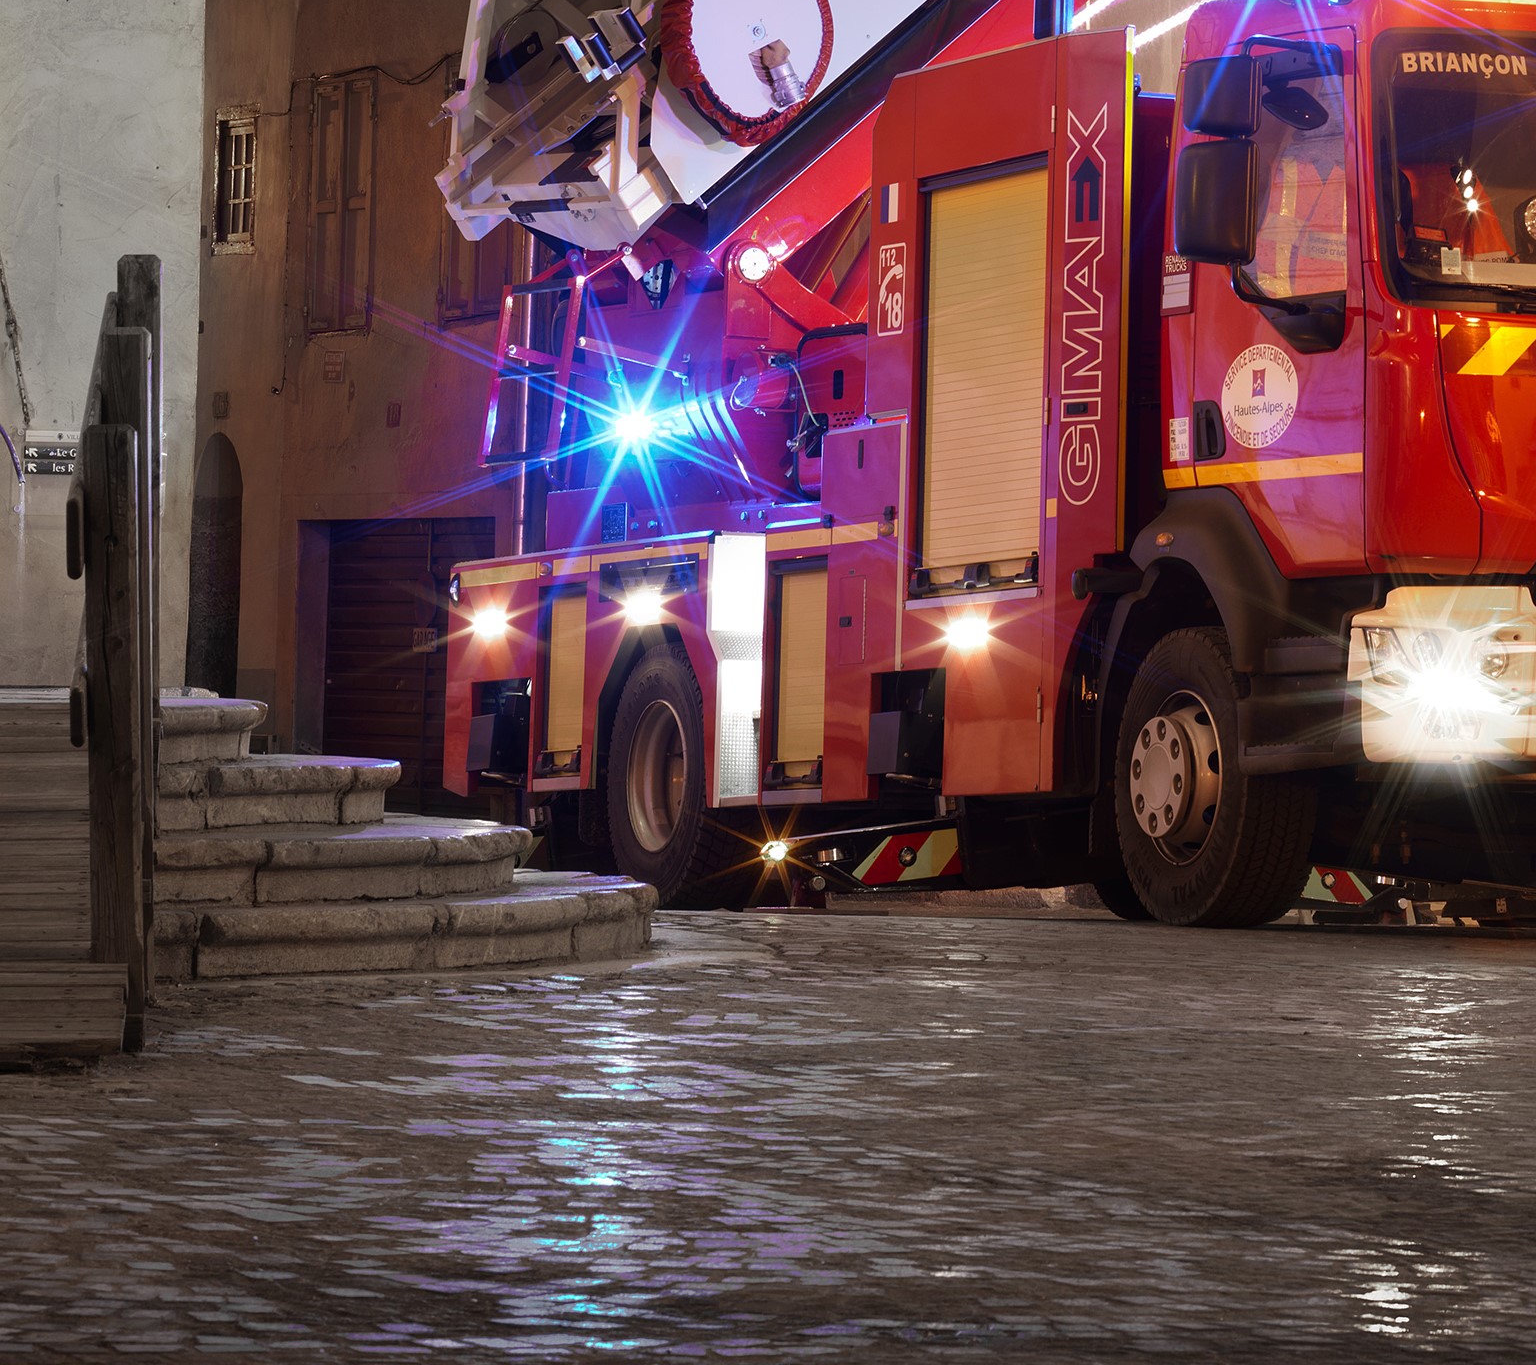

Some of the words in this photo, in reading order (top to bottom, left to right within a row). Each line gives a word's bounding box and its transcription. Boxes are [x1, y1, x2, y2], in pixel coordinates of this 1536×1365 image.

[1401, 52, 1528, 79] BRIANÇON
[881, 248, 896, 268] 112
[1165, 262, 1188, 274] TRUCKS
[885, 292, 902, 329] 18
[1059, 101, 1108, 506] GIMAEX
[1224, 351, 1248, 390] SERVICE
[1248, 345, 1295, 383] DEPARTEMENTAL
[1233, 401, 1284, 417] Hautes-Alpes
[1224, 410, 1252, 447] D'INCENDIE
[1252, 431, 1260, 447] ET
[1260, 429, 1269, 446] DE
[1269, 402, 1294, 442] SECOURS
[52, 463, 66, 472] les
